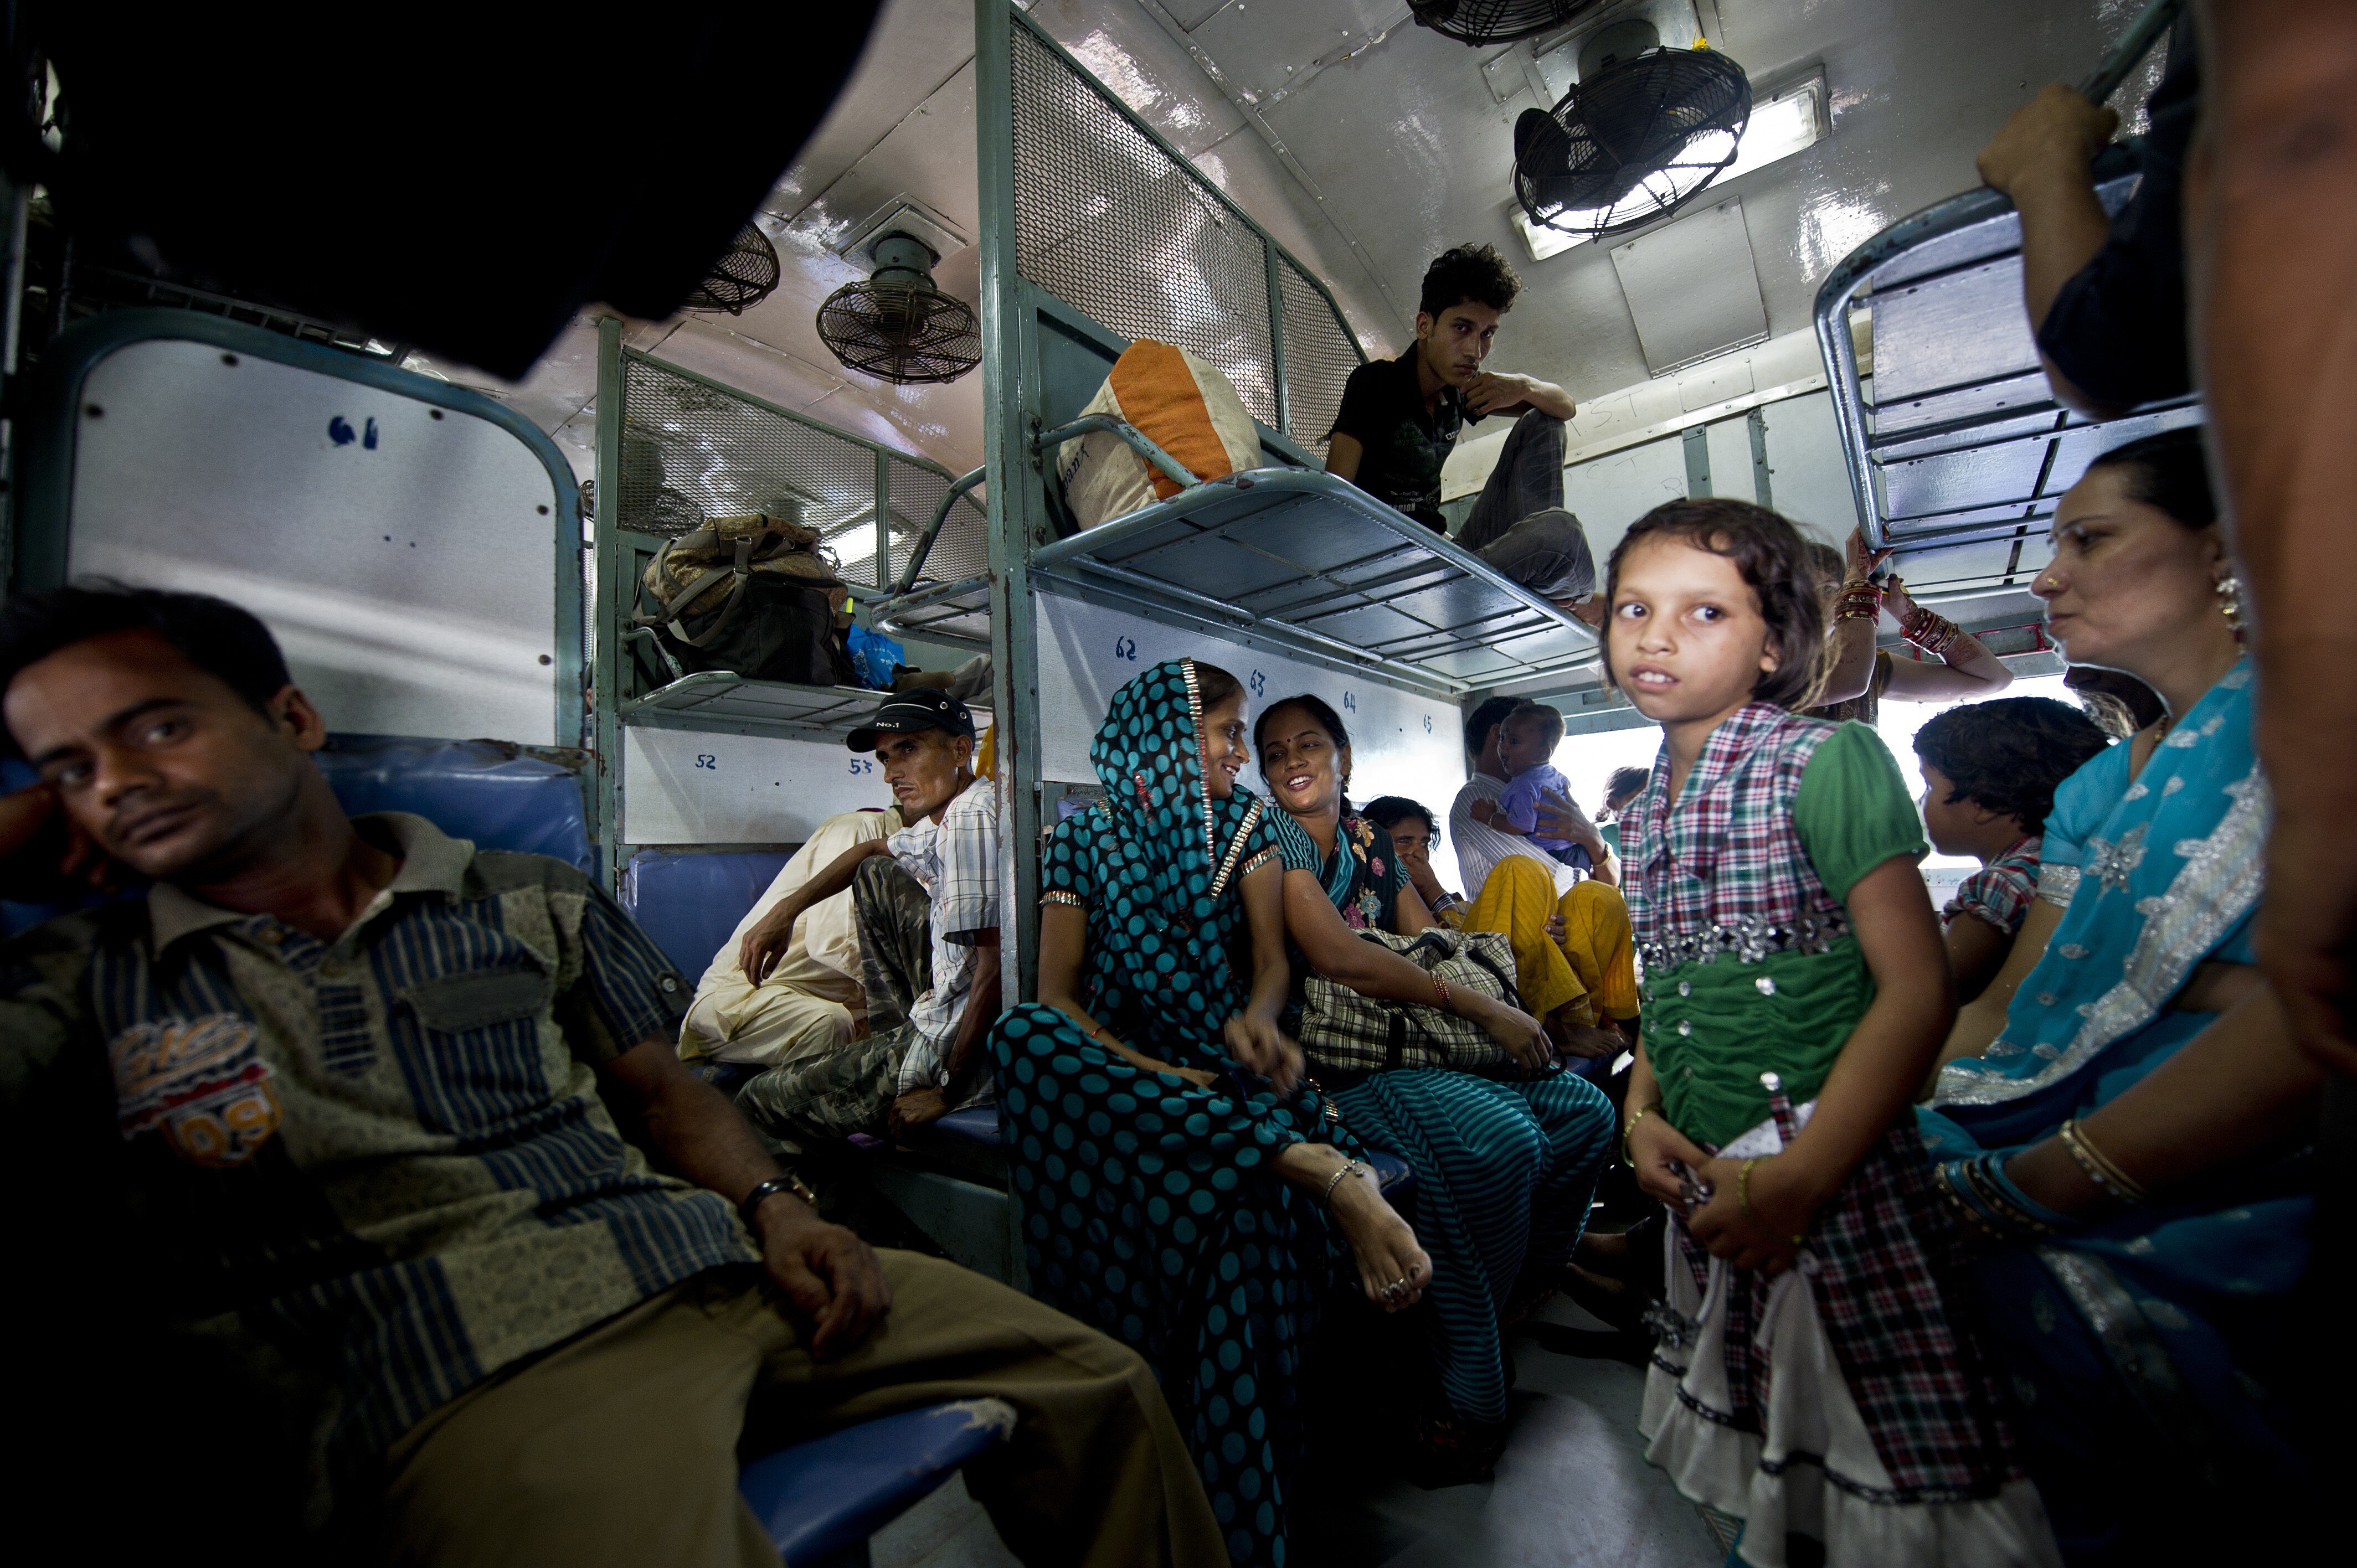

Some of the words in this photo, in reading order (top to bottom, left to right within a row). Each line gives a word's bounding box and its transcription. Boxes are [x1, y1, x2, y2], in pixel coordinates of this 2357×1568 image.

[328, 415, 379, 450] 61
[1116, 636, 1136, 661] 62
[1250, 669, 1265, 698] 63
[1344, 691, 1356, 714] 64
[1423, 714, 1432, 734] 65
[695, 754, 716, 770] 52
[848, 758, 872, 775] 53
